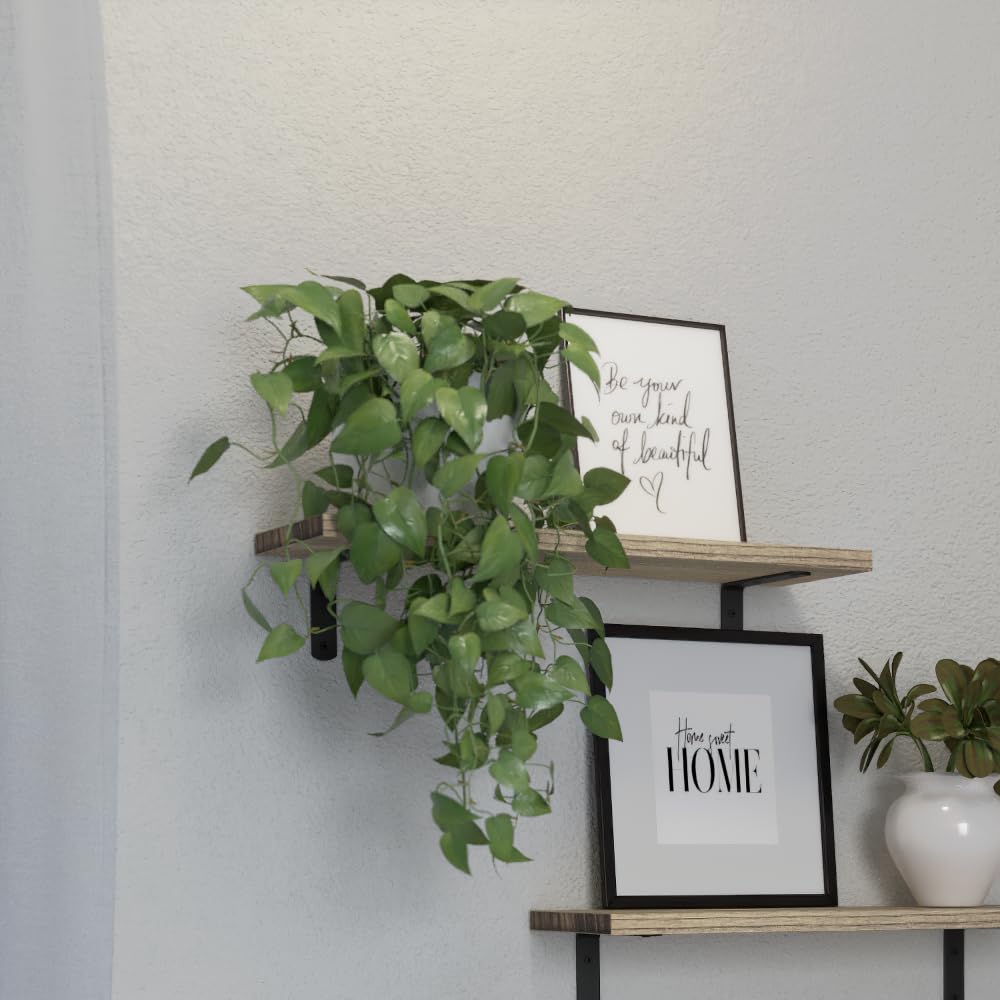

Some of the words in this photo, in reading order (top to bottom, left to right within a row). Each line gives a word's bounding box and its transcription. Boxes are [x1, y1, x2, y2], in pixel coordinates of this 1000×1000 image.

[601, 361, 628, 394] Be
[633, 376, 684, 408] your
[611, 410, 646, 425] own
[647, 391, 693, 428] kind
[612, 428, 630, 475] of
[633, 428, 712, 480] beautiful
[675, 717, 705, 761] Home
[666, 746, 762, 793] HOME
